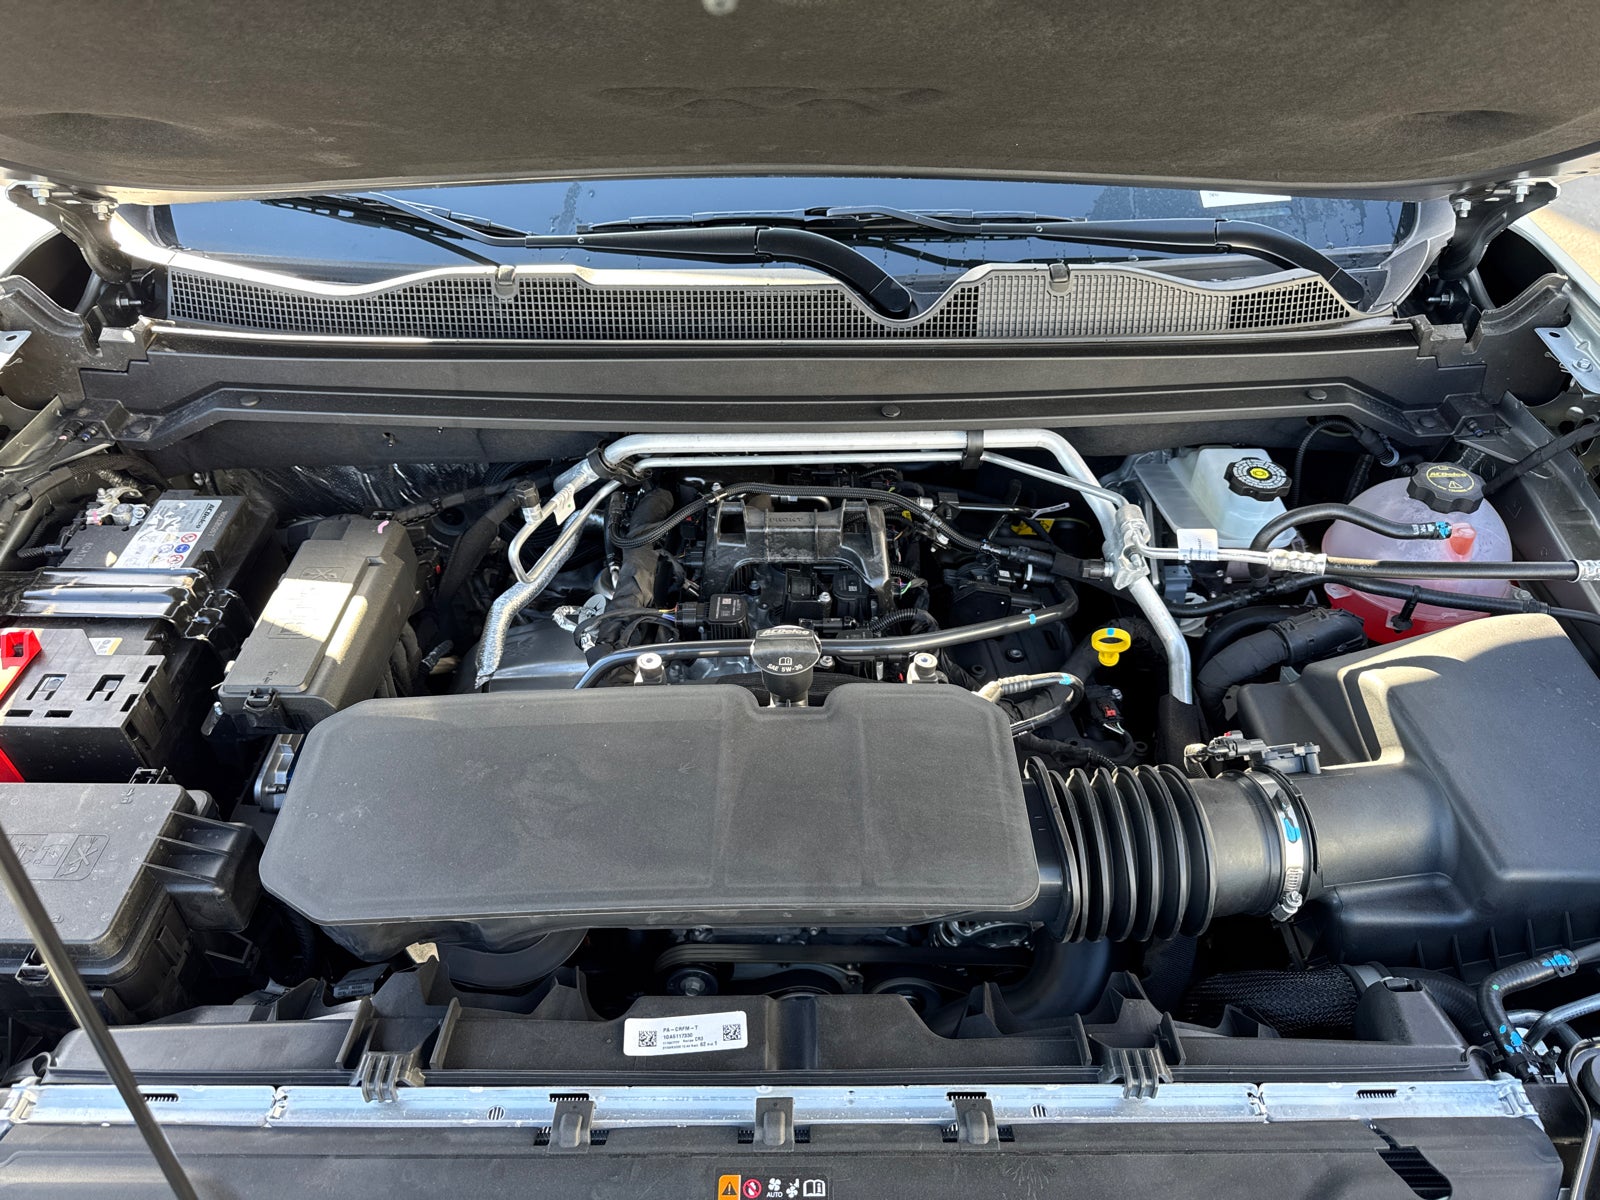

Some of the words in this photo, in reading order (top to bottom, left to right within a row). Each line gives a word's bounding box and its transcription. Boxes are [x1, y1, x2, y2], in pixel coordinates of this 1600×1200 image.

[196, 503, 215, 529] ACDelco
[759, 629, 810, 637] ACDelco
[766, 663, 779, 672] SAE
[781, 663, 804, 673] 5W-30
